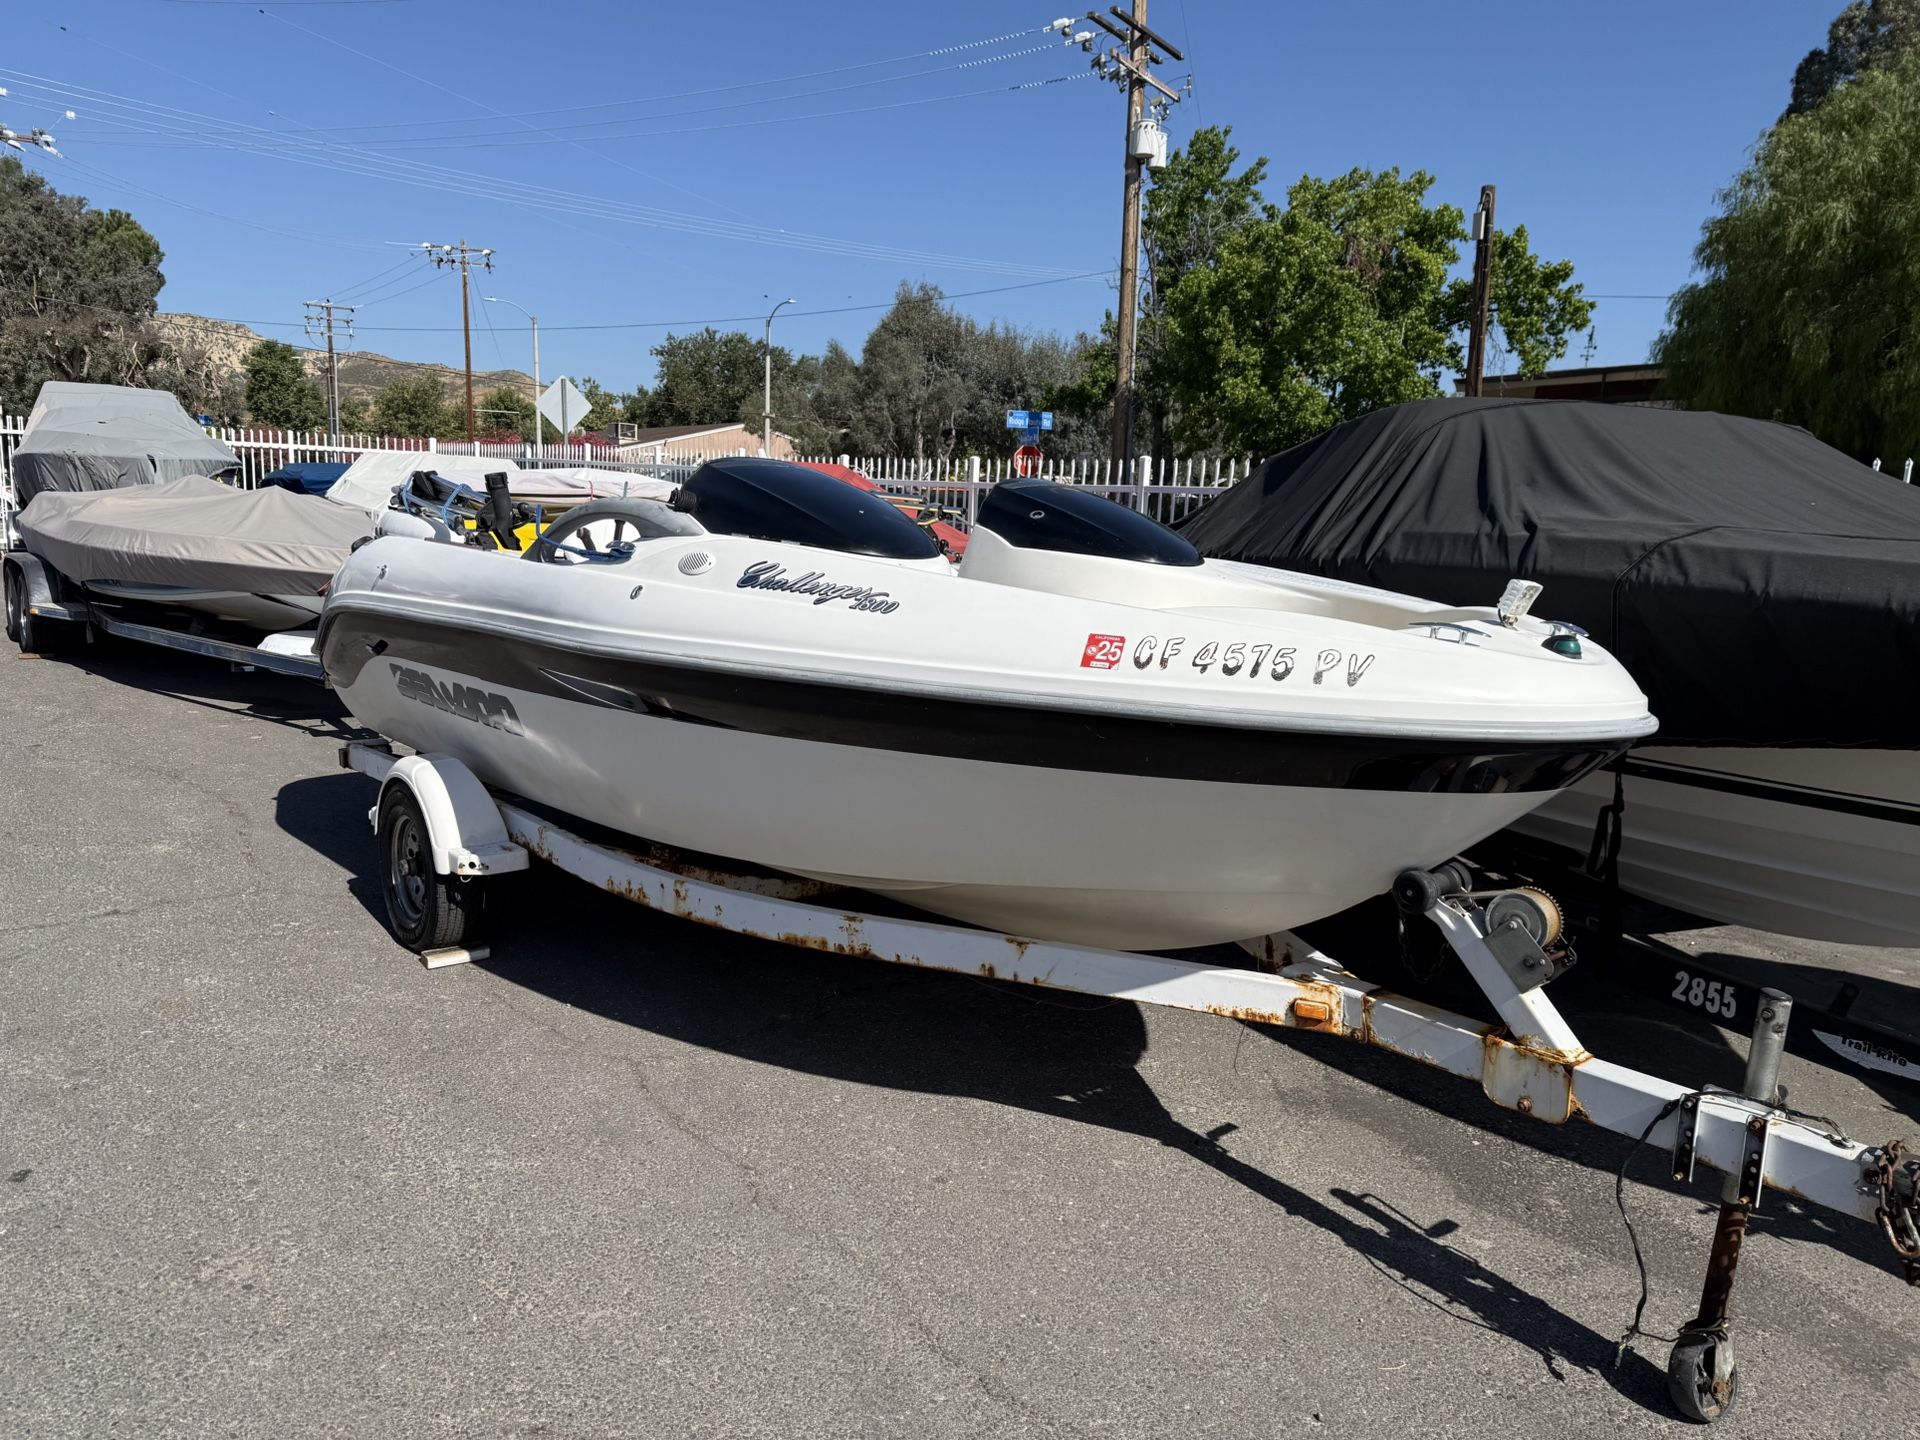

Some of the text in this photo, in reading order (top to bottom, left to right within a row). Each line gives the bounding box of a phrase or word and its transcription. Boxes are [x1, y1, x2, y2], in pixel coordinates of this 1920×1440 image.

[1016, 455, 1041, 467] STOP
[737, 560, 900, 614] Challenger 1800
[1095, 640, 1123, 661] 25
[1133, 635, 1375, 687] CF 4575 PV
[1671, 970, 1737, 1019] 2855
